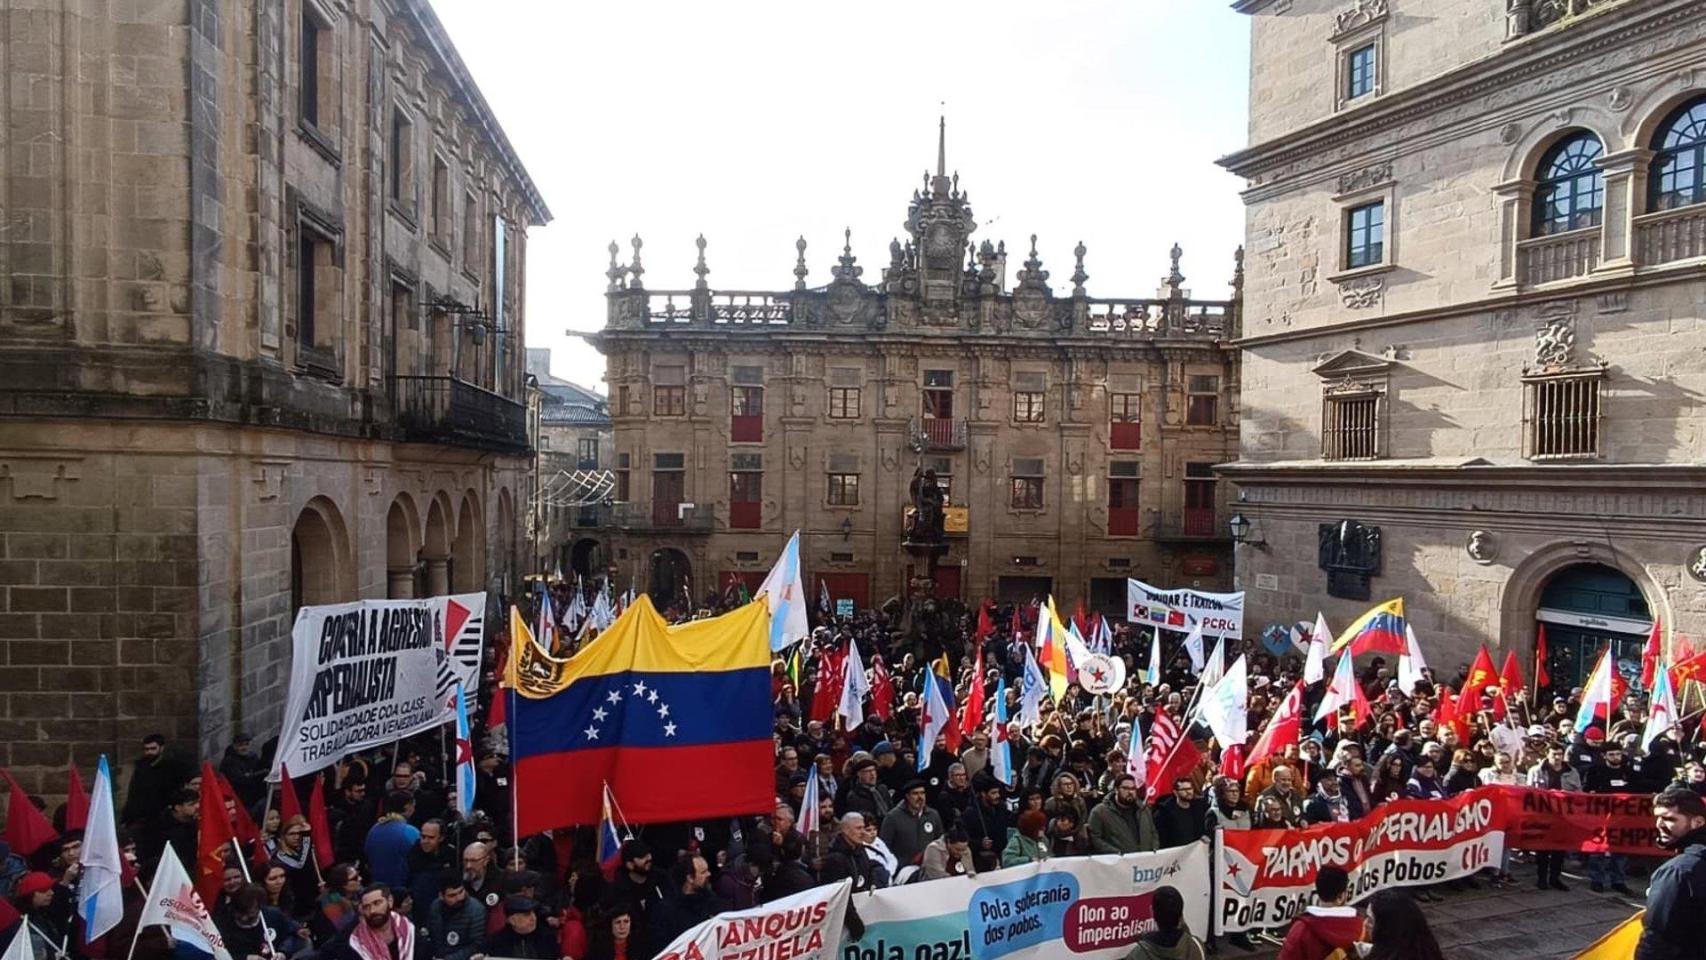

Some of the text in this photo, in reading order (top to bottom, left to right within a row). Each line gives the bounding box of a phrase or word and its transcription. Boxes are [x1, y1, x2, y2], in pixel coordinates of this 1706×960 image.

[367, 609, 378, 655] A
[1523, 792, 1651, 816] ANTI-IMPER
[1132, 865, 1163, 883] bng
[981, 884, 1070, 922] Pola soberanía
[1223, 898, 1266, 927] Pola
[1383, 856, 1448, 884] Pobos
[984, 913, 1042, 946] dos pobos.
[1079, 904, 1129, 924] Non ao
[1078, 917, 1159, 946] imperialism
